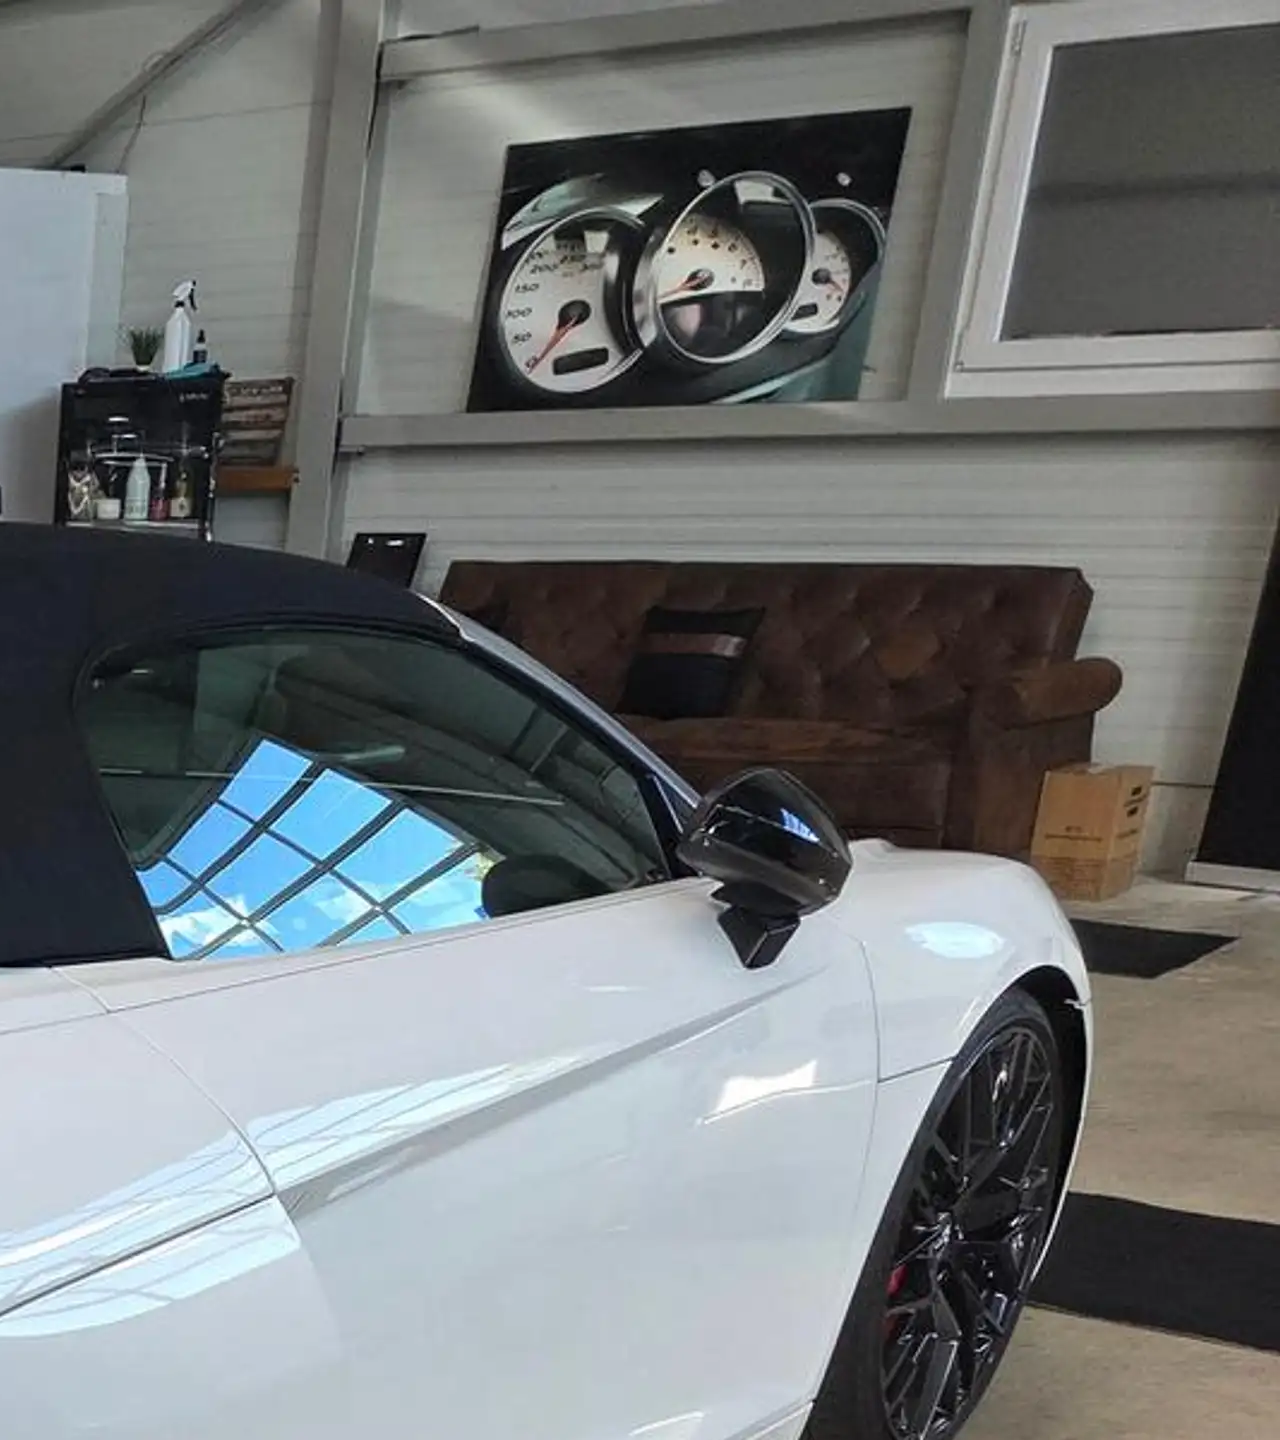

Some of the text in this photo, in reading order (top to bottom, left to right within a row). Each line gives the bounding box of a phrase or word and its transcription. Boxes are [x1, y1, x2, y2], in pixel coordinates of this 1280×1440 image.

[515, 283, 540, 294] 150
[506, 307, 532, 320] 100
[512, 332, 533, 344] 50
